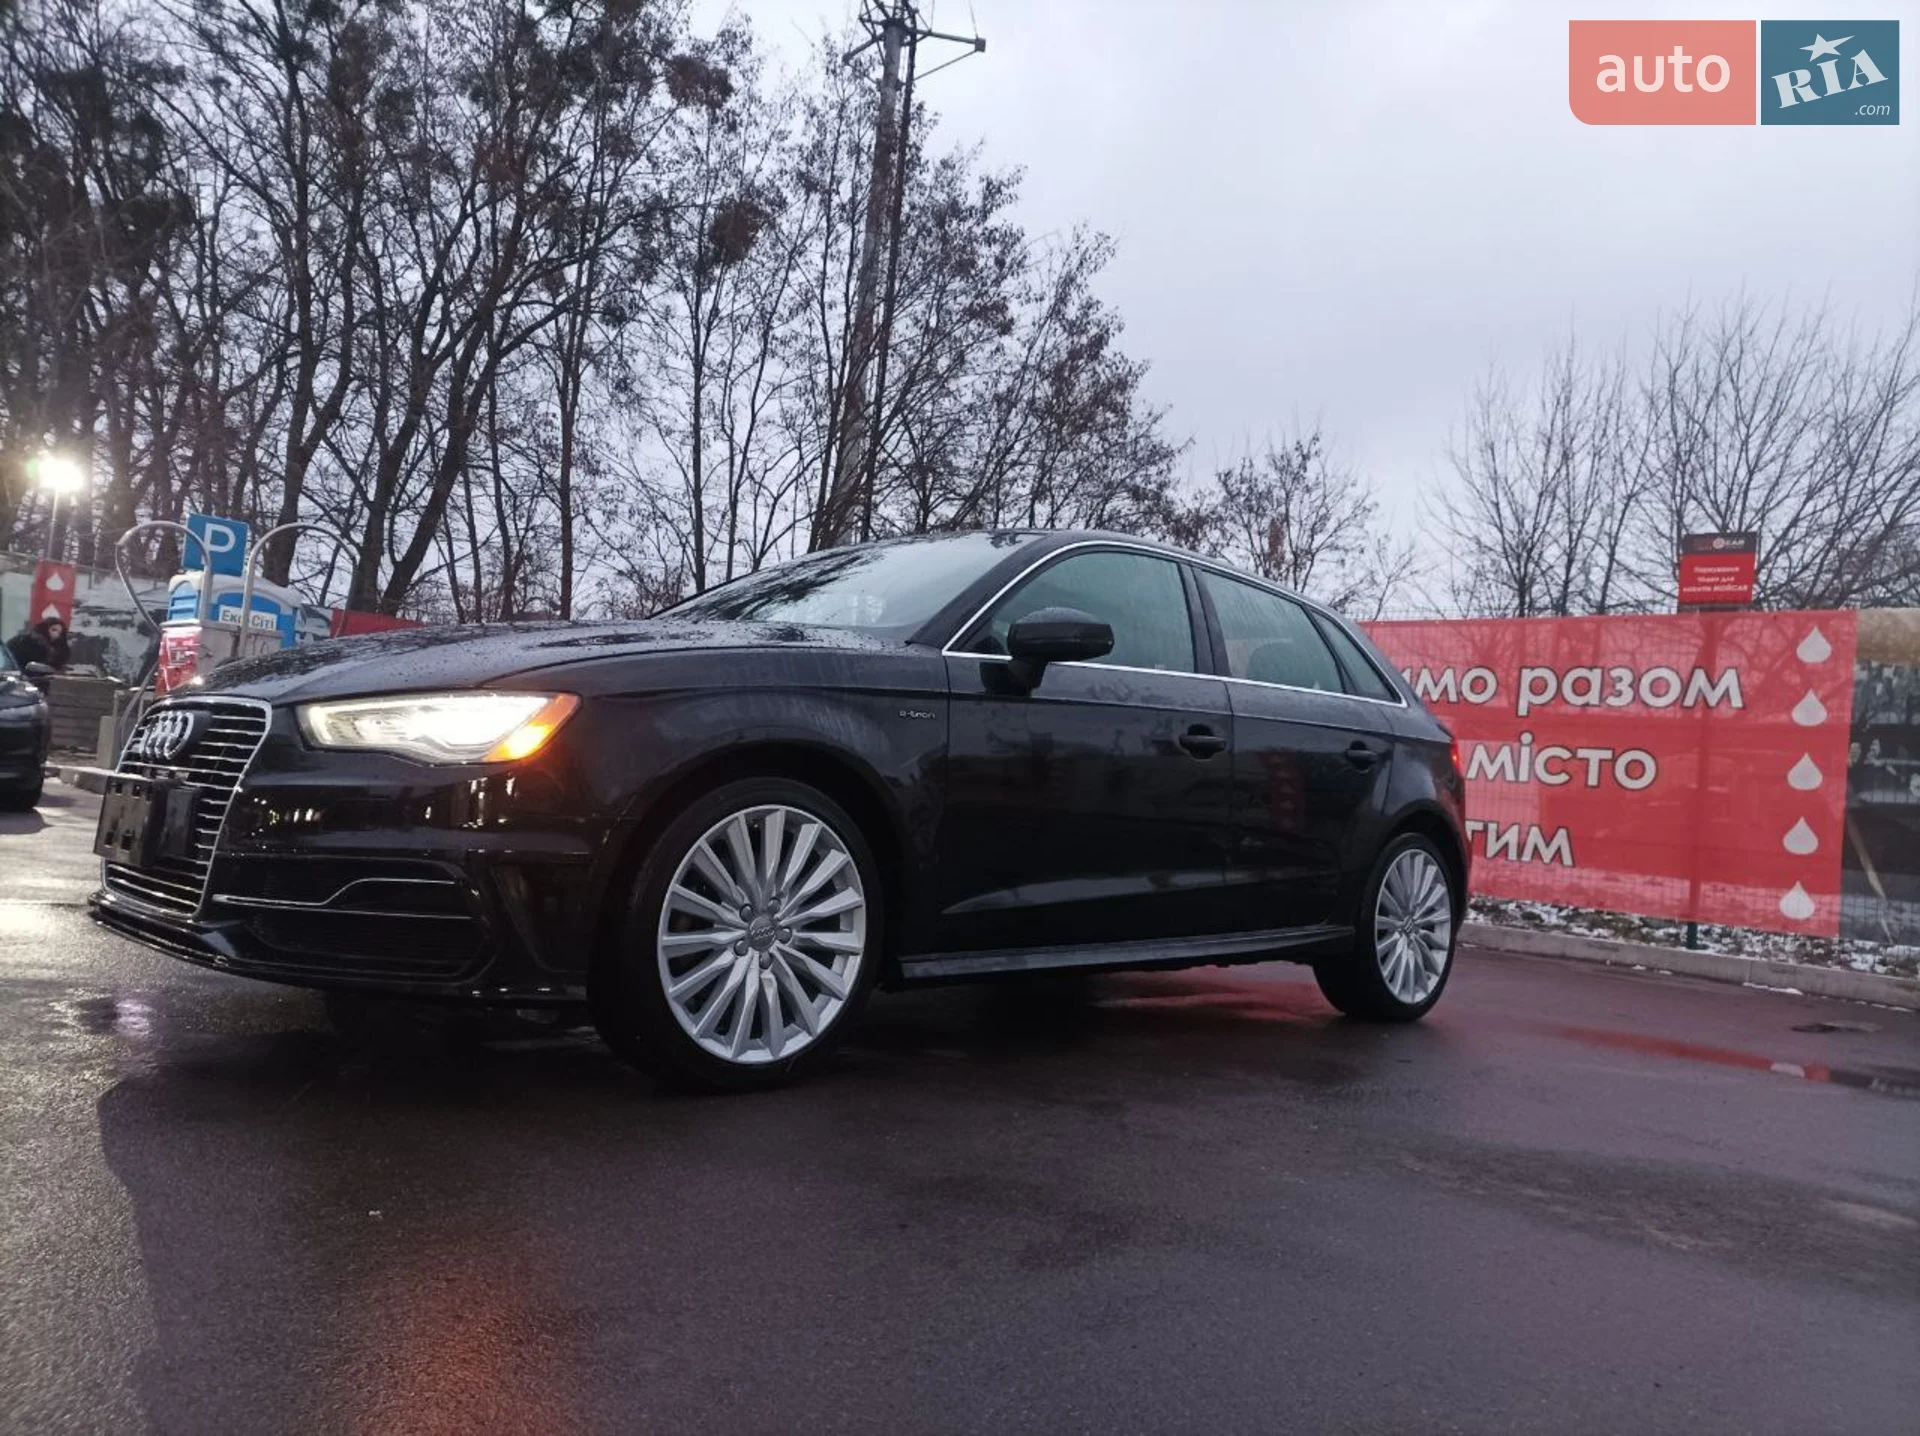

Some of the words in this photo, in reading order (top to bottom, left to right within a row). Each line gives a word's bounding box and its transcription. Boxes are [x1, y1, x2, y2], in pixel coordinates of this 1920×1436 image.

[201, 522, 236, 565] P
[1401, 667, 1498, 704] мо
[1516, 666, 1744, 717] разом
[1466, 731, 1657, 790] місто
